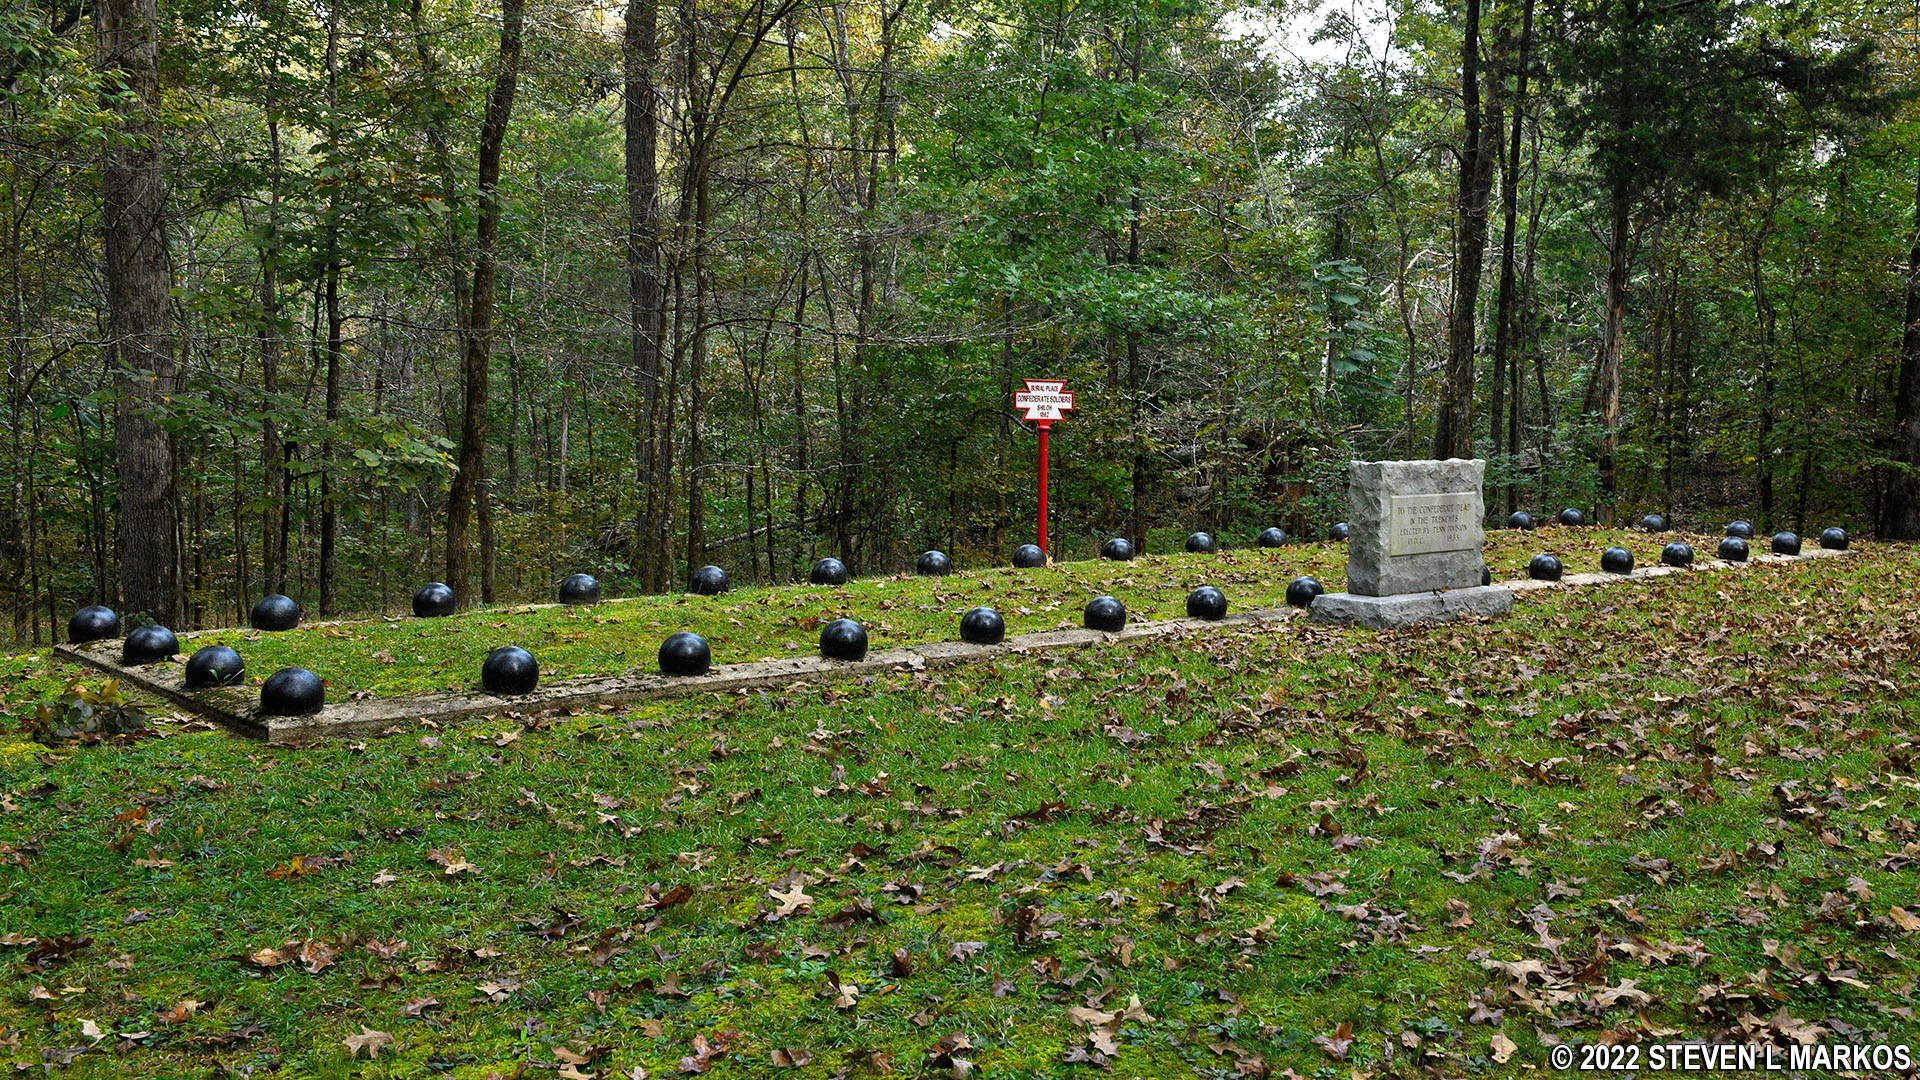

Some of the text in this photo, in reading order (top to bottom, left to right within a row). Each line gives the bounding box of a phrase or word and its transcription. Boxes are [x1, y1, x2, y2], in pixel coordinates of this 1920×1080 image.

[1050, 395, 1071, 403] SOLDIERS
[1397, 503, 1471, 515] TO THE CONFEDERATE DEAD
[1410, 515, 1459, 525] IN THE TRENCHES
[1400, 527, 1421, 536] ERECTED
[1447, 524, 1467, 532] DIVISION
